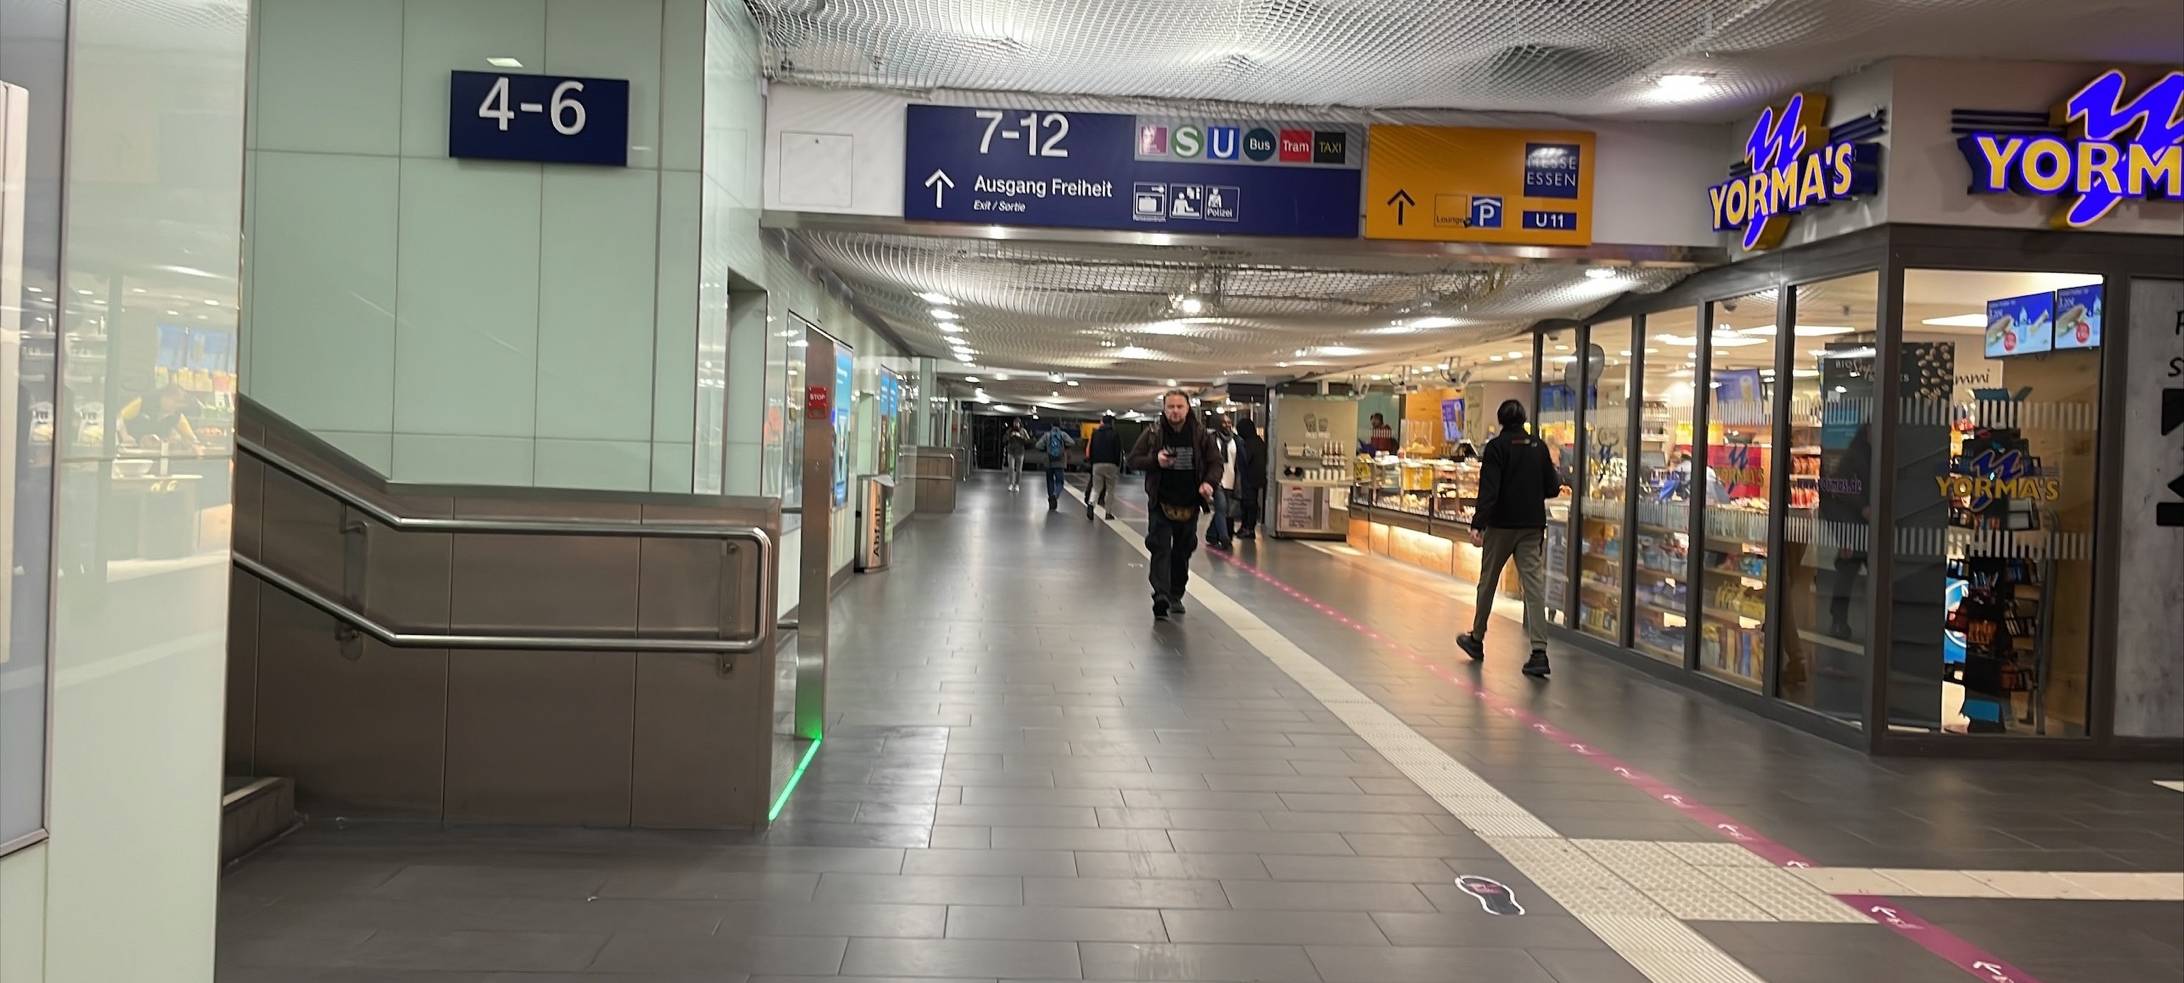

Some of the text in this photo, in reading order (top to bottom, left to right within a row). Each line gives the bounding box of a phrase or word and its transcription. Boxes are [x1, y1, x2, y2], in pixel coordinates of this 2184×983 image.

[479, 76, 586, 135] 4-6
[975, 109, 1069, 157] 7-12
[1176, 126, 1342, 158] S U Bus Tram TAXI
[974, 175, 1113, 198] Ausgang Freiheit
[1526, 171, 1576, 187] ESSEN
[1709, 142, 1853, 230] YORMA'S
[973, 199, 991, 211] Exit
[999, 201, 1026, 212] Sortie
[1207, 208, 1233, 218] Polizei
[1479, 205, 1495, 226] P
[1535, 212, 1564, 228] U 11
[809, 393, 826, 401] STOP
[1935, 474, 2060, 501] YORMA'S
[873, 508, 881, 557] Abfall
